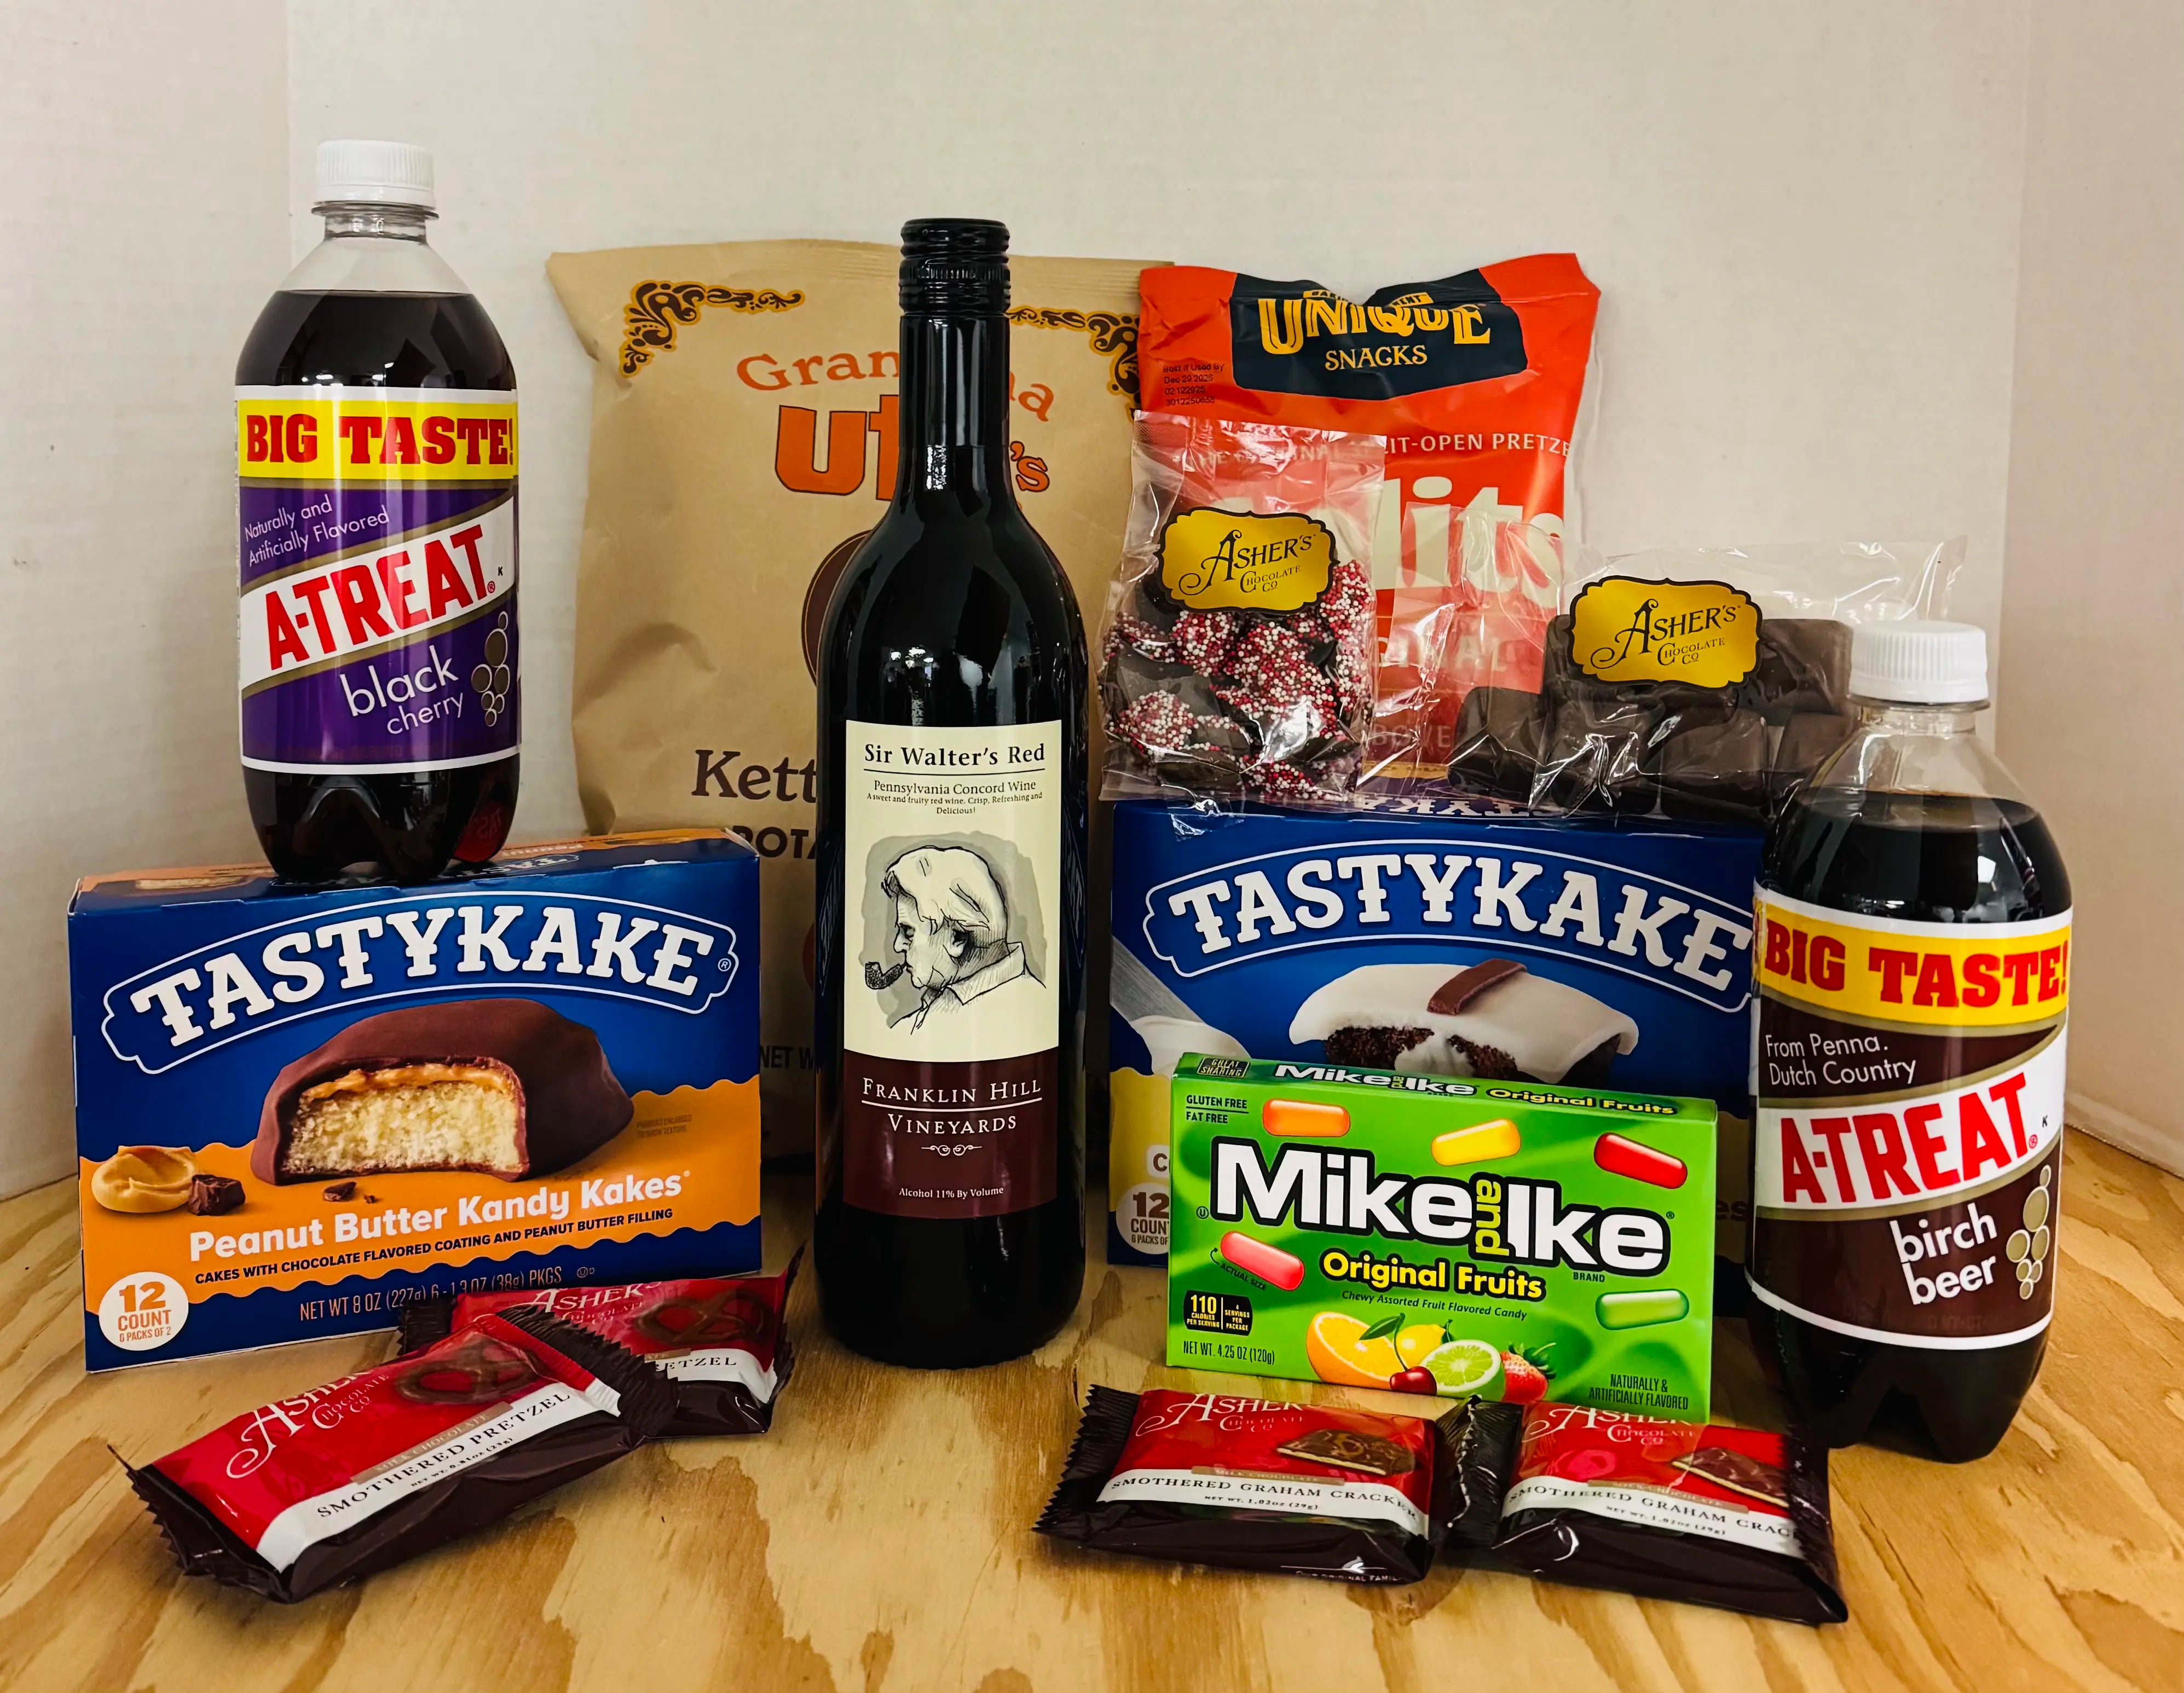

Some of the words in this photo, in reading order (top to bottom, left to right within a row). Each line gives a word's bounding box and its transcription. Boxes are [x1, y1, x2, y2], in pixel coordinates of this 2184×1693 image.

[1258, 298, 1492, 355] UNIQUE
[1325, 345, 1428, 371] SNACKS
[736, 350, 1054, 421] Grana
[246, 413, 317, 463] BIG
[339, 416, 513, 465] TASTE!
[245, 513, 296, 542] Naturally
[301, 494, 333, 520] and
[249, 532, 310, 567] Artificially
[314, 504, 390, 536] Flavored
[497, 566, 503, 576] K
[1178, 529, 1313, 596] ASHER'S
[1239, 564, 1302, 594] CHOCOLATE
[1262, 580, 1279, 593] CO
[1590, 598, 1737, 669] ASHER'S
[1657, 637, 1726, 666] CHOCOLATE
[1682, 651, 1699, 665] CO
[339, 645, 459, 718] black
[386, 692, 465, 736] cherry
[865, 743, 892, 763] Sir
[900, 747, 998, 766] Walter's
[1007, 743, 1045, 764] Red
[691, 749, 817, 804] Kett
[874, 780, 950, 796] Pennsylvania
[953, 782, 1005, 794] Concord
[1008, 780, 1036, 792] Wine
[892, 795, 906, 803] and
[908, 797, 929, 805] fruity
[968, 796, 990, 805] Crisp,
[992, 794, 1030, 803] Refreshing
[732, 825, 816, 860] POT
[1168, 853, 1754, 991] TASTYKAKE
[130, 906, 714, 1047] TASTYKAKE
[1765, 918, 1846, 992] BIG
[1869, 940, 2069, 1009] TASTE!
[1766, 1032, 1805, 1059] From
[1811, 1032, 1888, 1055] Penna.
[1275, 1064, 1391, 1087] Mike
[1406, 1077, 1475, 1095] Ike
[1770, 1063, 1817, 1087] Dutch
[1822, 1059, 1917, 1085] Country
[863, 1077, 976, 1102] FRANKLIN
[990, 1079, 1041, 1100] HILL
[1186, 1095, 1222, 1107] GLUTEN
[1225, 1097, 1247, 1109] FREE
[1489, 1088, 1593, 1107] Original
[1603, 1098, 1675, 1115] Fruits
[887, 1113, 1016, 1134] VINEYARDS
[1186, 1112, 1203, 1122] FAT
[1206, 1113, 1228, 1124] FREE
[2042, 1116, 2048, 1128] K
[899, 1187, 933, 1198] Alcohol
[936, 1189, 955, 1198] 11%
[957, 1190, 968, 1199] By
[970, 1187, 1004, 1197] Volume
[1133, 1192, 1169, 1218] 12
[1217, 1143, 1474, 1238] Mike
[1474, 1180, 1509, 1257] and
[1506, 1183, 1663, 1268] Ike
[189, 1218, 324, 1262] Peanut
[334, 1199, 443, 1243] Butter
[458, 1187, 570, 1226] Kandy
[581, 1174, 683, 1210] Kakes
[195, 1269, 240, 1285] CAKES
[243, 1263, 278, 1277] WITH
[281, 1252, 361, 1272] CHOCOLATE
[363, 1240, 431, 1262] FLAVORED
[434, 1234, 491, 1251] COATING
[494, 1230, 521, 1244] AND
[524, 1222, 574, 1240] PEANUT
[577, 1215, 625, 1231] BUTTER
[628, 1208, 673, 1224] FILLING
[1137, 1235, 1158, 1245] PACKS
[1160, 1236, 1169, 1246] OF
[1889, 1203, 1998, 1264] birch
[1221, 1263, 1248, 1282] ACTUAL
[1323, 1251, 1446, 1291] Original
[1457, 1266, 1543, 1299] Fruits
[1573, 1272, 1605, 1282] BRAND
[1902, 1253, 1997, 1306] beer
[119, 1281, 166, 1313] 12
[300, 1301, 324, 1320] NET
[329, 1296, 349, 1314] WT
[354, 1295, 360, 1312] 8
[365, 1292, 381, 1310] OZ
[386, 1286, 426, 1310] (227g)
[529, 1266, 562, 1286] PKGS
[1191, 1295, 1216, 1314] 110
[1342, 1291, 1374, 1304] Chewy
[1377, 1295, 1419, 1307] Assorted
[1422, 1299, 1445, 1310] Fruit
[1448, 1302, 1491, 1315] Flavored
[1494, 1307, 1527, 1321] Candy
[118, 1310, 171, 1331] COUNT
[126, 1330, 153, 1341] PACKS
[155, 1327, 164, 1337] OF
[166, 1326, 171, 1336] 2
[1183, 1341, 1198, 1354] NET
[1200, 1343, 1215, 1356] WT.
[1217, 1344, 1234, 1359] 4.25
[1237, 1347, 1247, 1359] OZ
[1249, 1348, 1275, 1365] (120g)
[1610, 1374, 1659, 1391] NATURALLY
[1661, 1378, 1668, 1392] &
[312, 1374, 389, 1429] CHOCOLATE
[350, 1396, 371, 1413] CO
[1589, 1387, 1644, 1405] ARTIFICIALLY
[1646, 1393, 1688, 1410] FLAVORED
[317, 1445, 464, 1517] SMOTHERED
[470, 1393, 570, 1444] PRETZEL
[411, 1478, 429, 1487] NET
[431, 1470, 448, 1479] WT.
[1112, 1477, 1230, 1489] SMOTHERED
[1240, 1483, 1321, 1497] GRAHAM
[1289, 1501, 1319, 1510] (29g)
[1509, 1485, 1632, 1504] SMOTHERED
[1642, 1497, 1726, 1523] GRAHAM
[1606, 1505, 1626, 1514] NET
